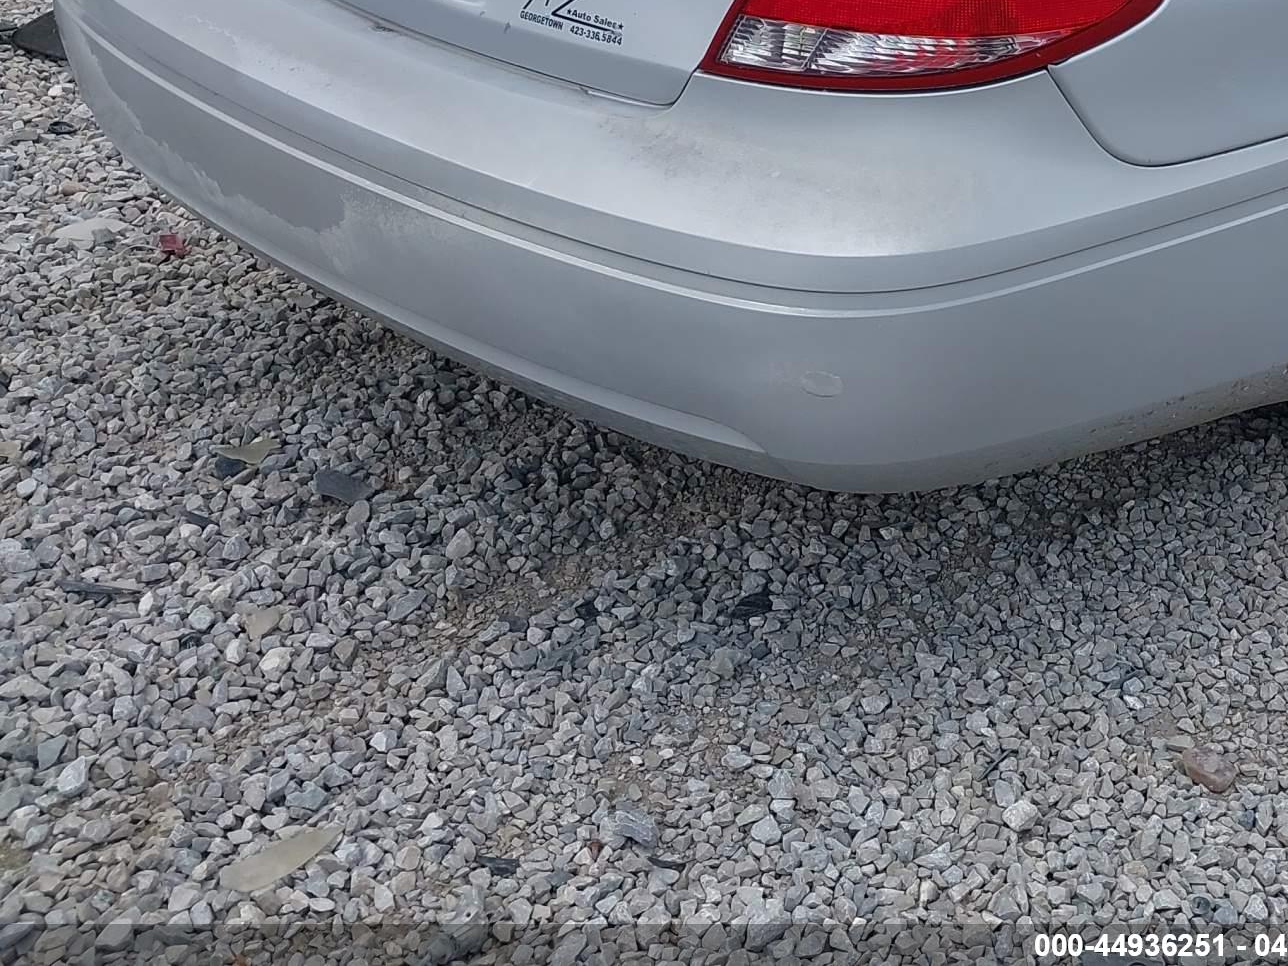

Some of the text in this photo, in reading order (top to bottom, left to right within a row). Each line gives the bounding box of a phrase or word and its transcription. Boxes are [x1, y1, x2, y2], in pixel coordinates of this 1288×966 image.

[520, 10, 564, 31] GEORGETOWN
[571, 9, 617, 29] Auto Sales
